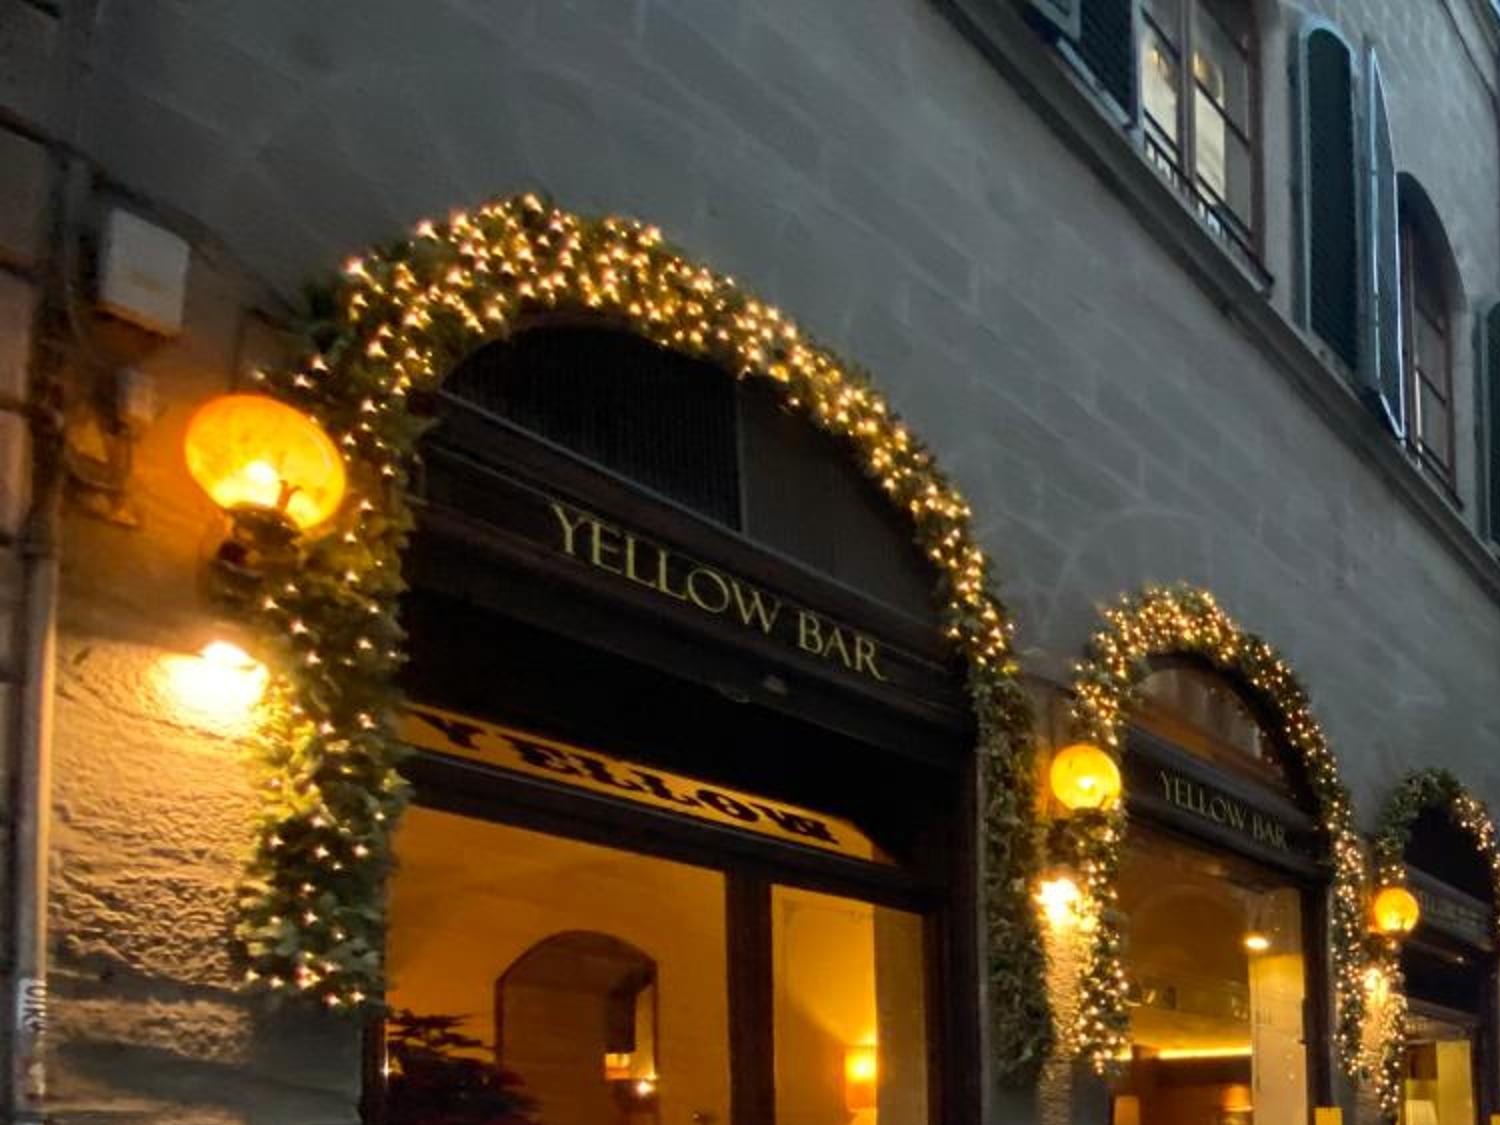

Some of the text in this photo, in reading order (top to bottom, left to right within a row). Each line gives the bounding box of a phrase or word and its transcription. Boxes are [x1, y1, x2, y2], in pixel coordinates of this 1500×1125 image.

[551, 501, 888, 682] YELLOW BAR
[403, 708, 840, 845] YELLOW
[1159, 769, 1289, 850] YELLOW BAR
